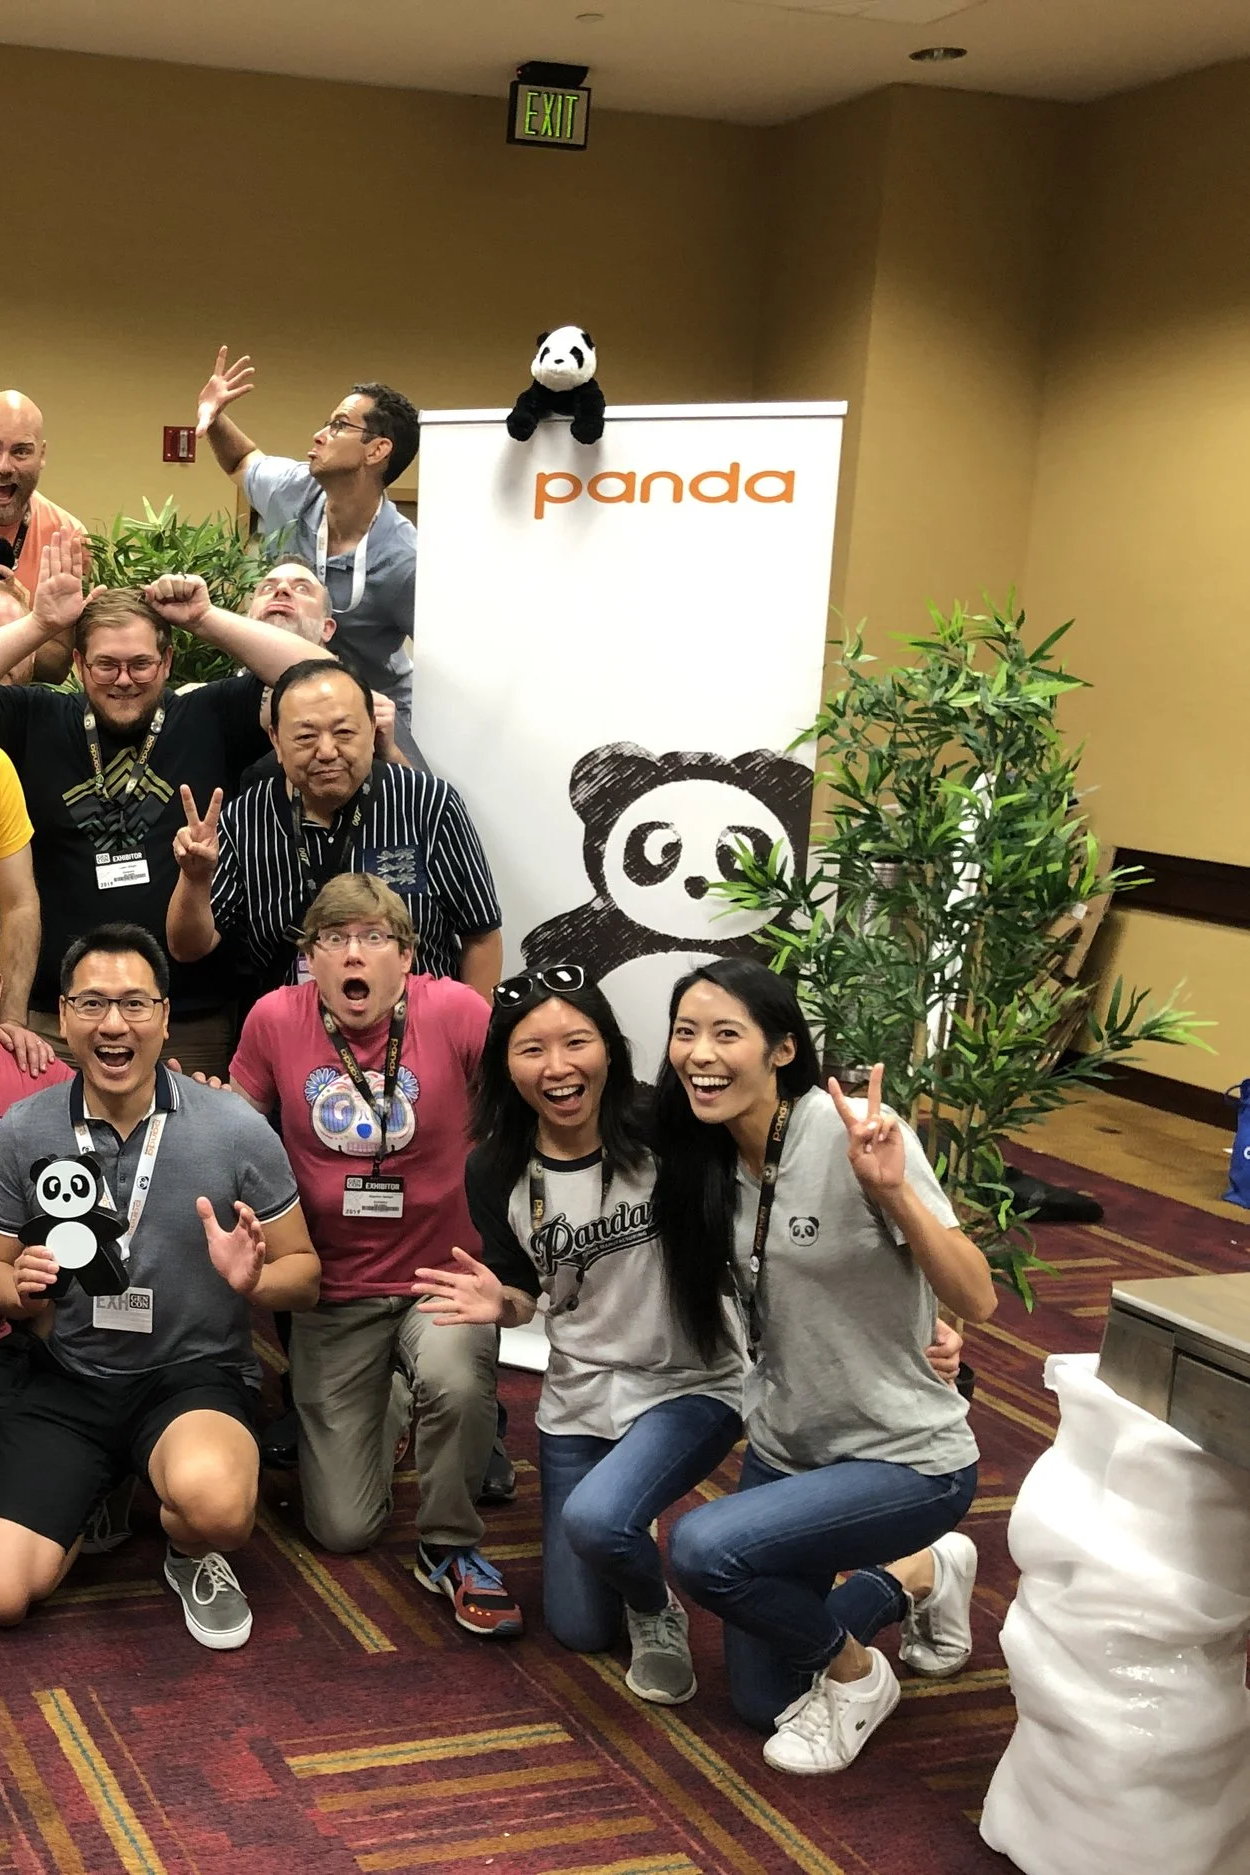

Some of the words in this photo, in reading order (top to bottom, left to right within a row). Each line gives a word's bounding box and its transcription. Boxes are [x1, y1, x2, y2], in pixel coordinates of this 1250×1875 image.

[524, 92, 579, 138] EXIT
[534, 462, 795, 520] panda
[139, 734, 155, 765] panda
[340, 1048, 363, 1084] panda
[388, 1038, 399, 1077] panda
[146, 1119, 161, 1156] panda
[530, 1201, 653, 1277] Panda
[130, 1294, 150, 1302] GEN
[130, 1300, 150, 1309] CON
